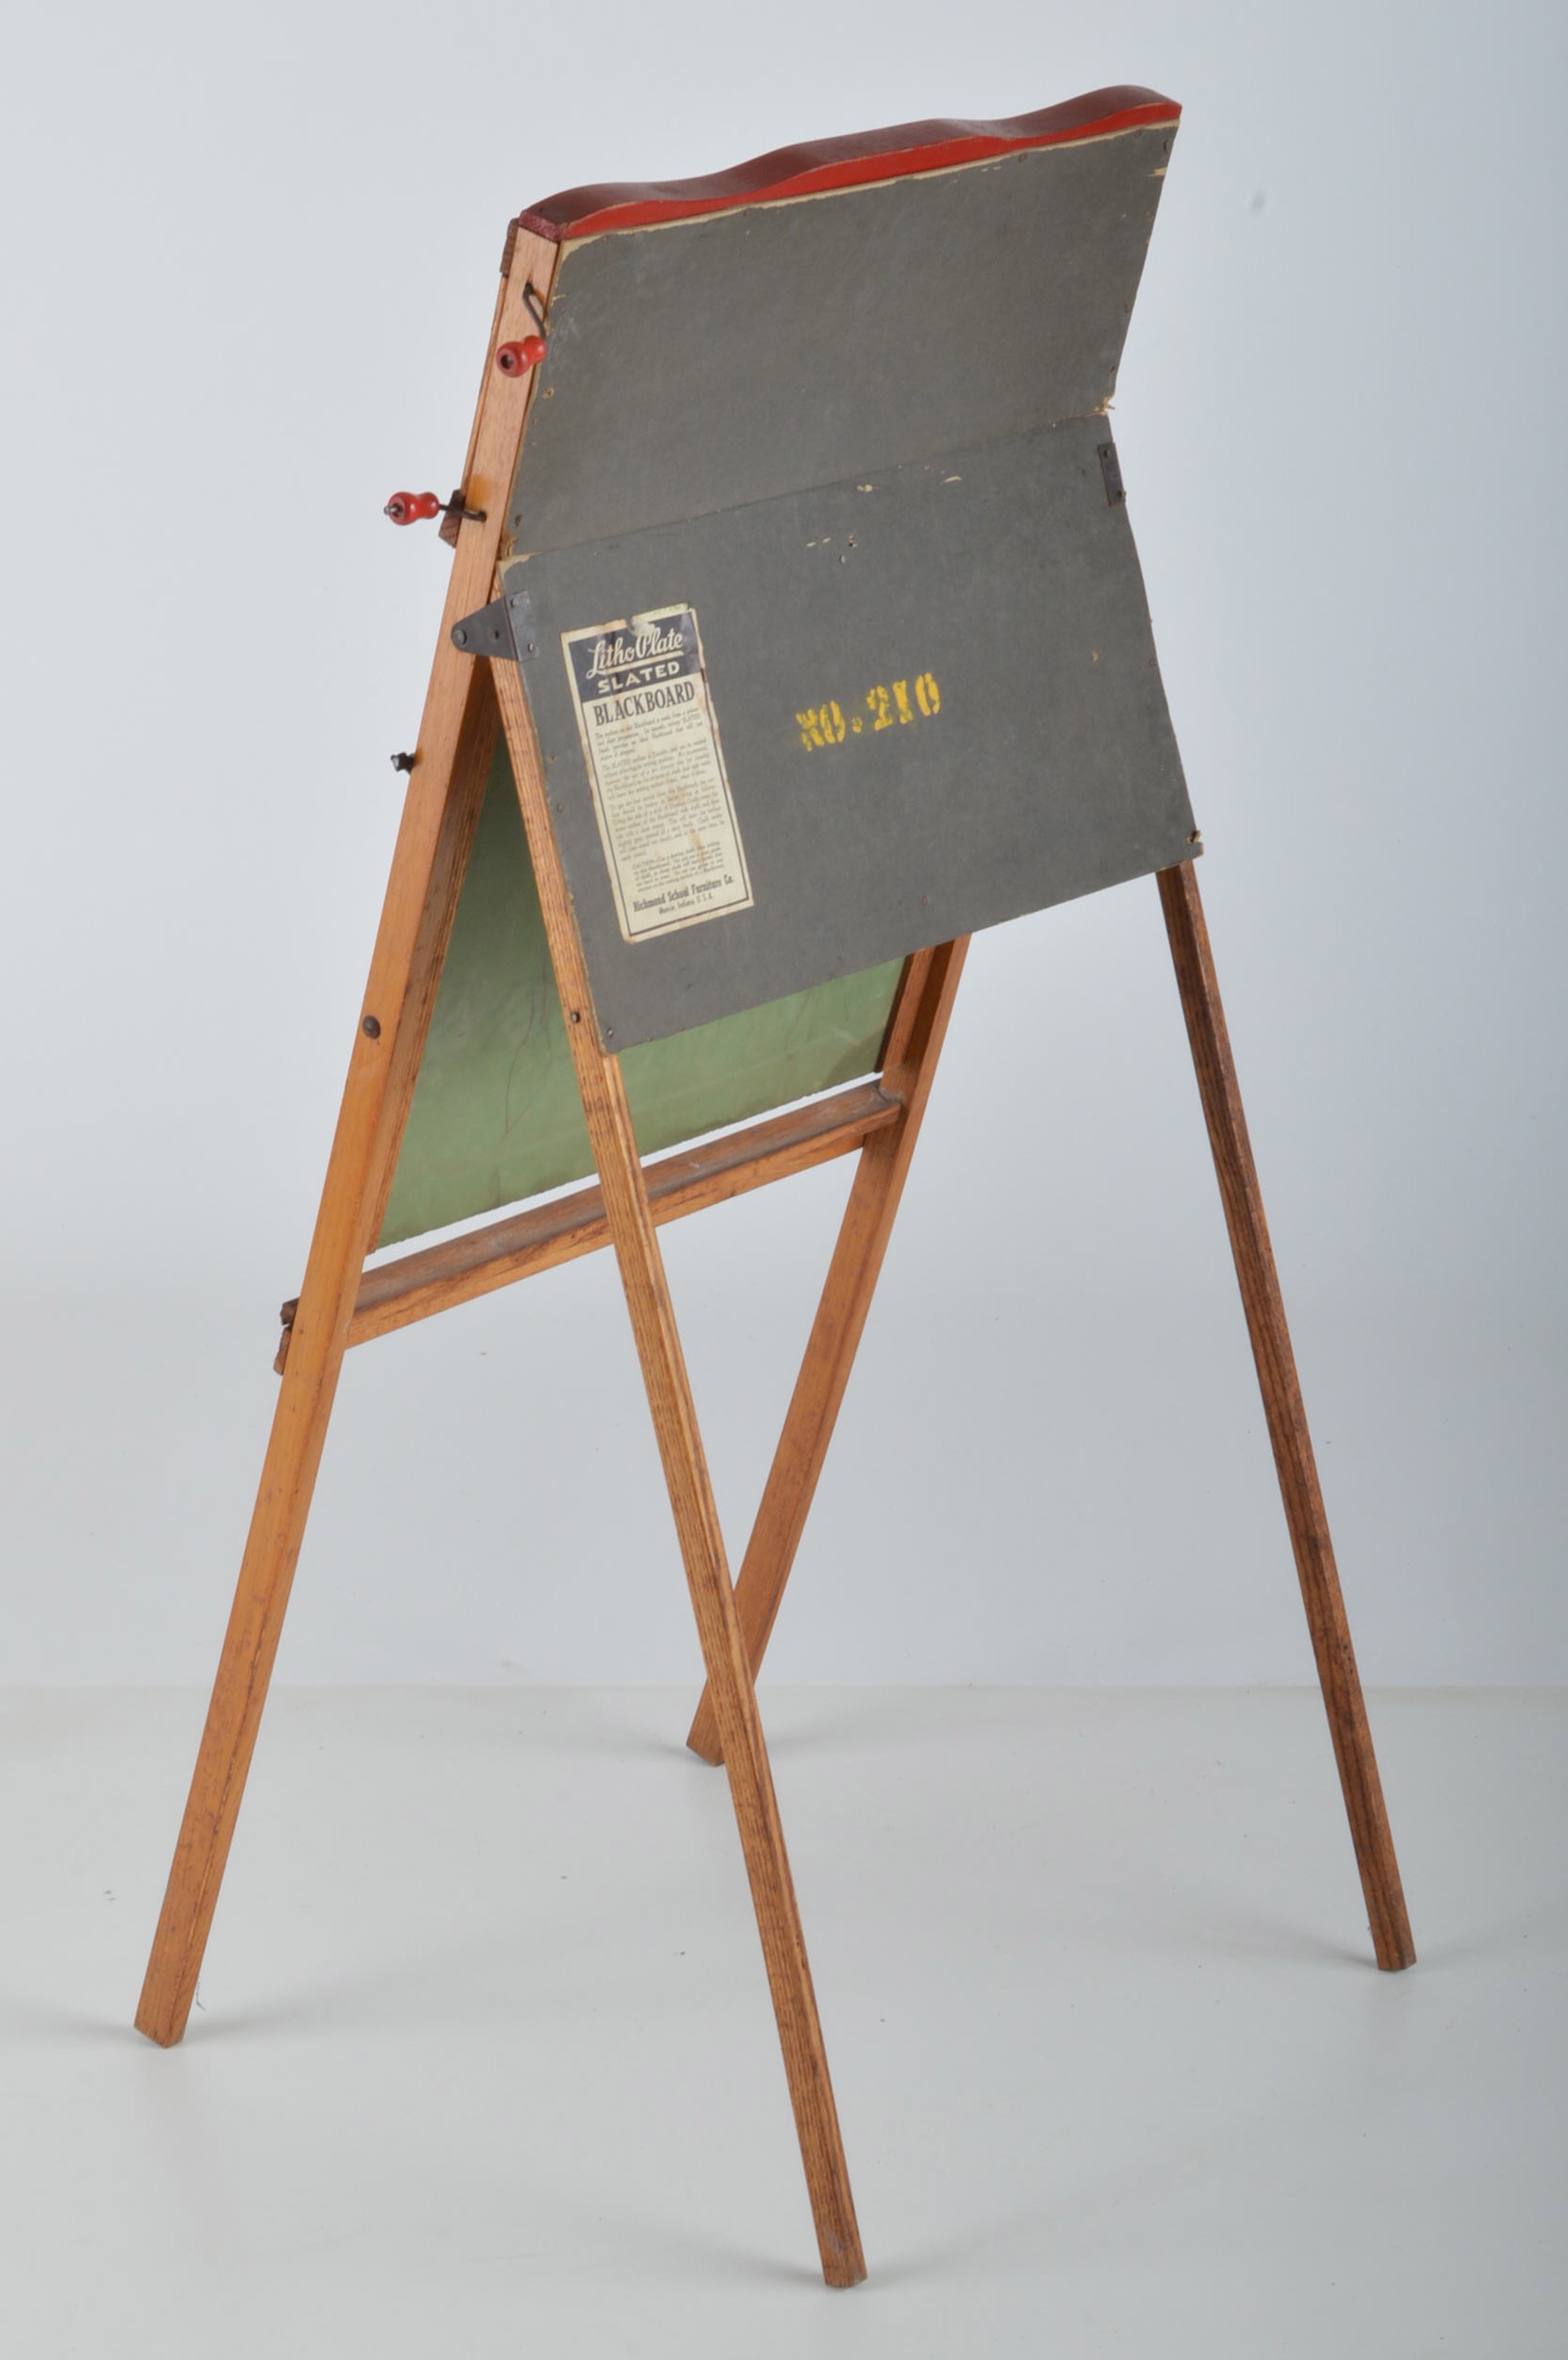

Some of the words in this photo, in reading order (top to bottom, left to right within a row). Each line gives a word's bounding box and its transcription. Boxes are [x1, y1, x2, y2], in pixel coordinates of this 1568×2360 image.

[598, 661, 680, 694] SLATED
[593, 681, 695, 727] BLACKBOARD
[633, 893, 666, 912] Richmond
[667, 886, 689, 902] School
[691, 879, 721, 895] Furniture
